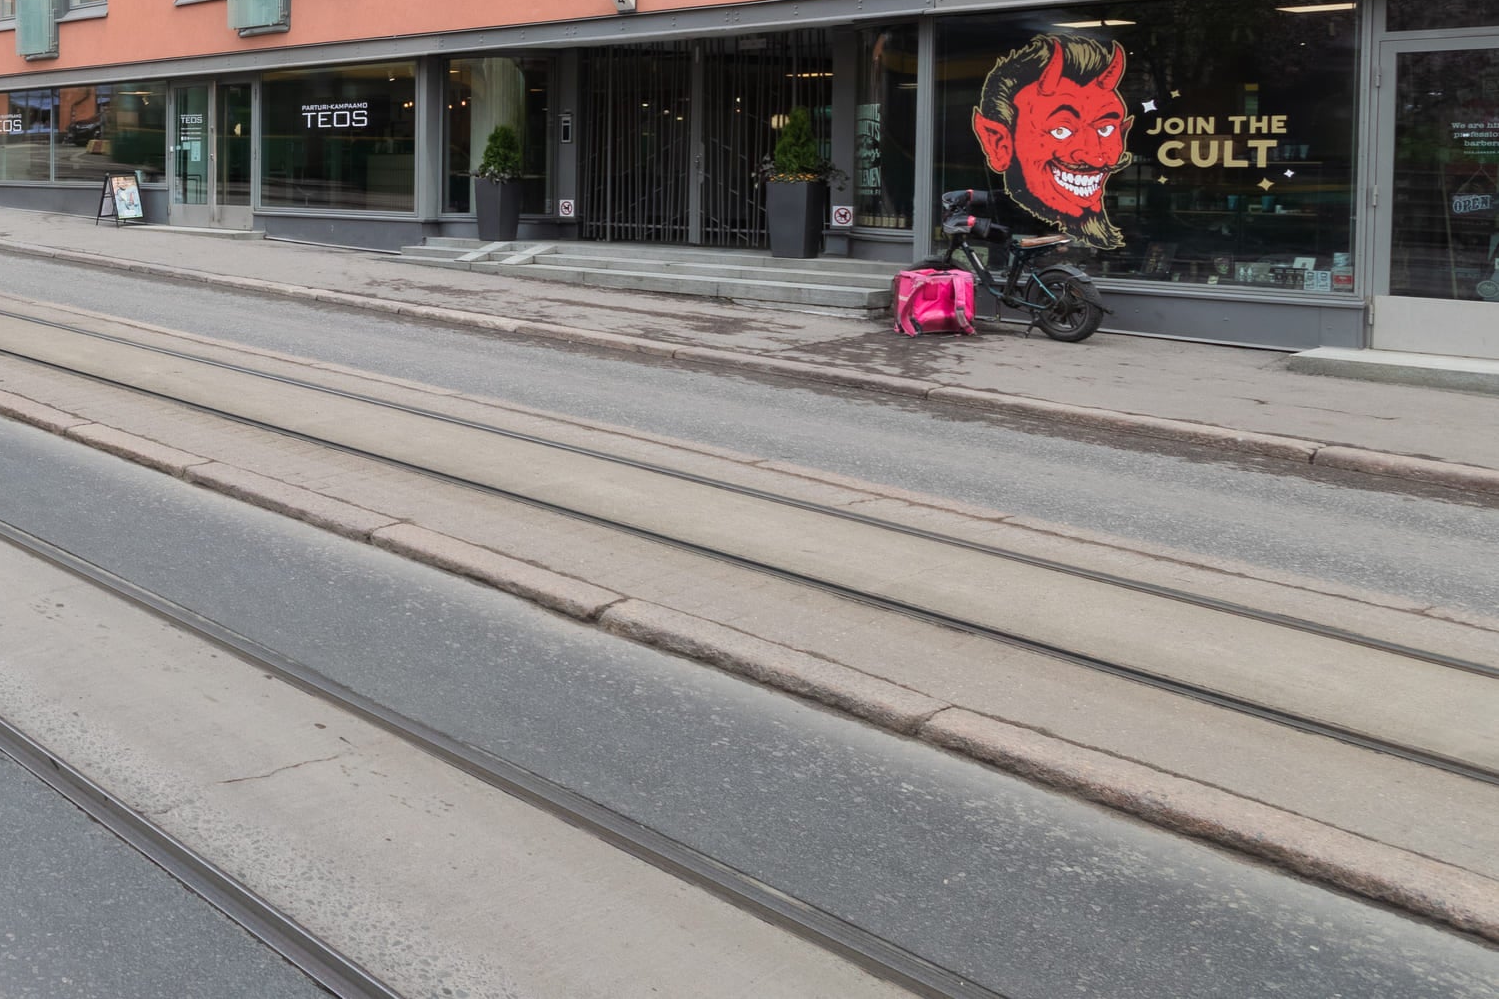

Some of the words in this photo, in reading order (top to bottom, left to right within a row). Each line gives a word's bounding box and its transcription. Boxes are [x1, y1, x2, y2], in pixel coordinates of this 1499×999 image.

[302, 102, 368, 110] PARTURI-KAMPAAMO
[181, 116, 203, 124] TEOS
[302, 110, 368, 128] TEOS
[1146, 116, 1215, 135] JOIN
[1228, 115, 1288, 134] THE
[1157, 139, 1278, 168] CULT
[1453, 195, 1491, 214] OPEN
